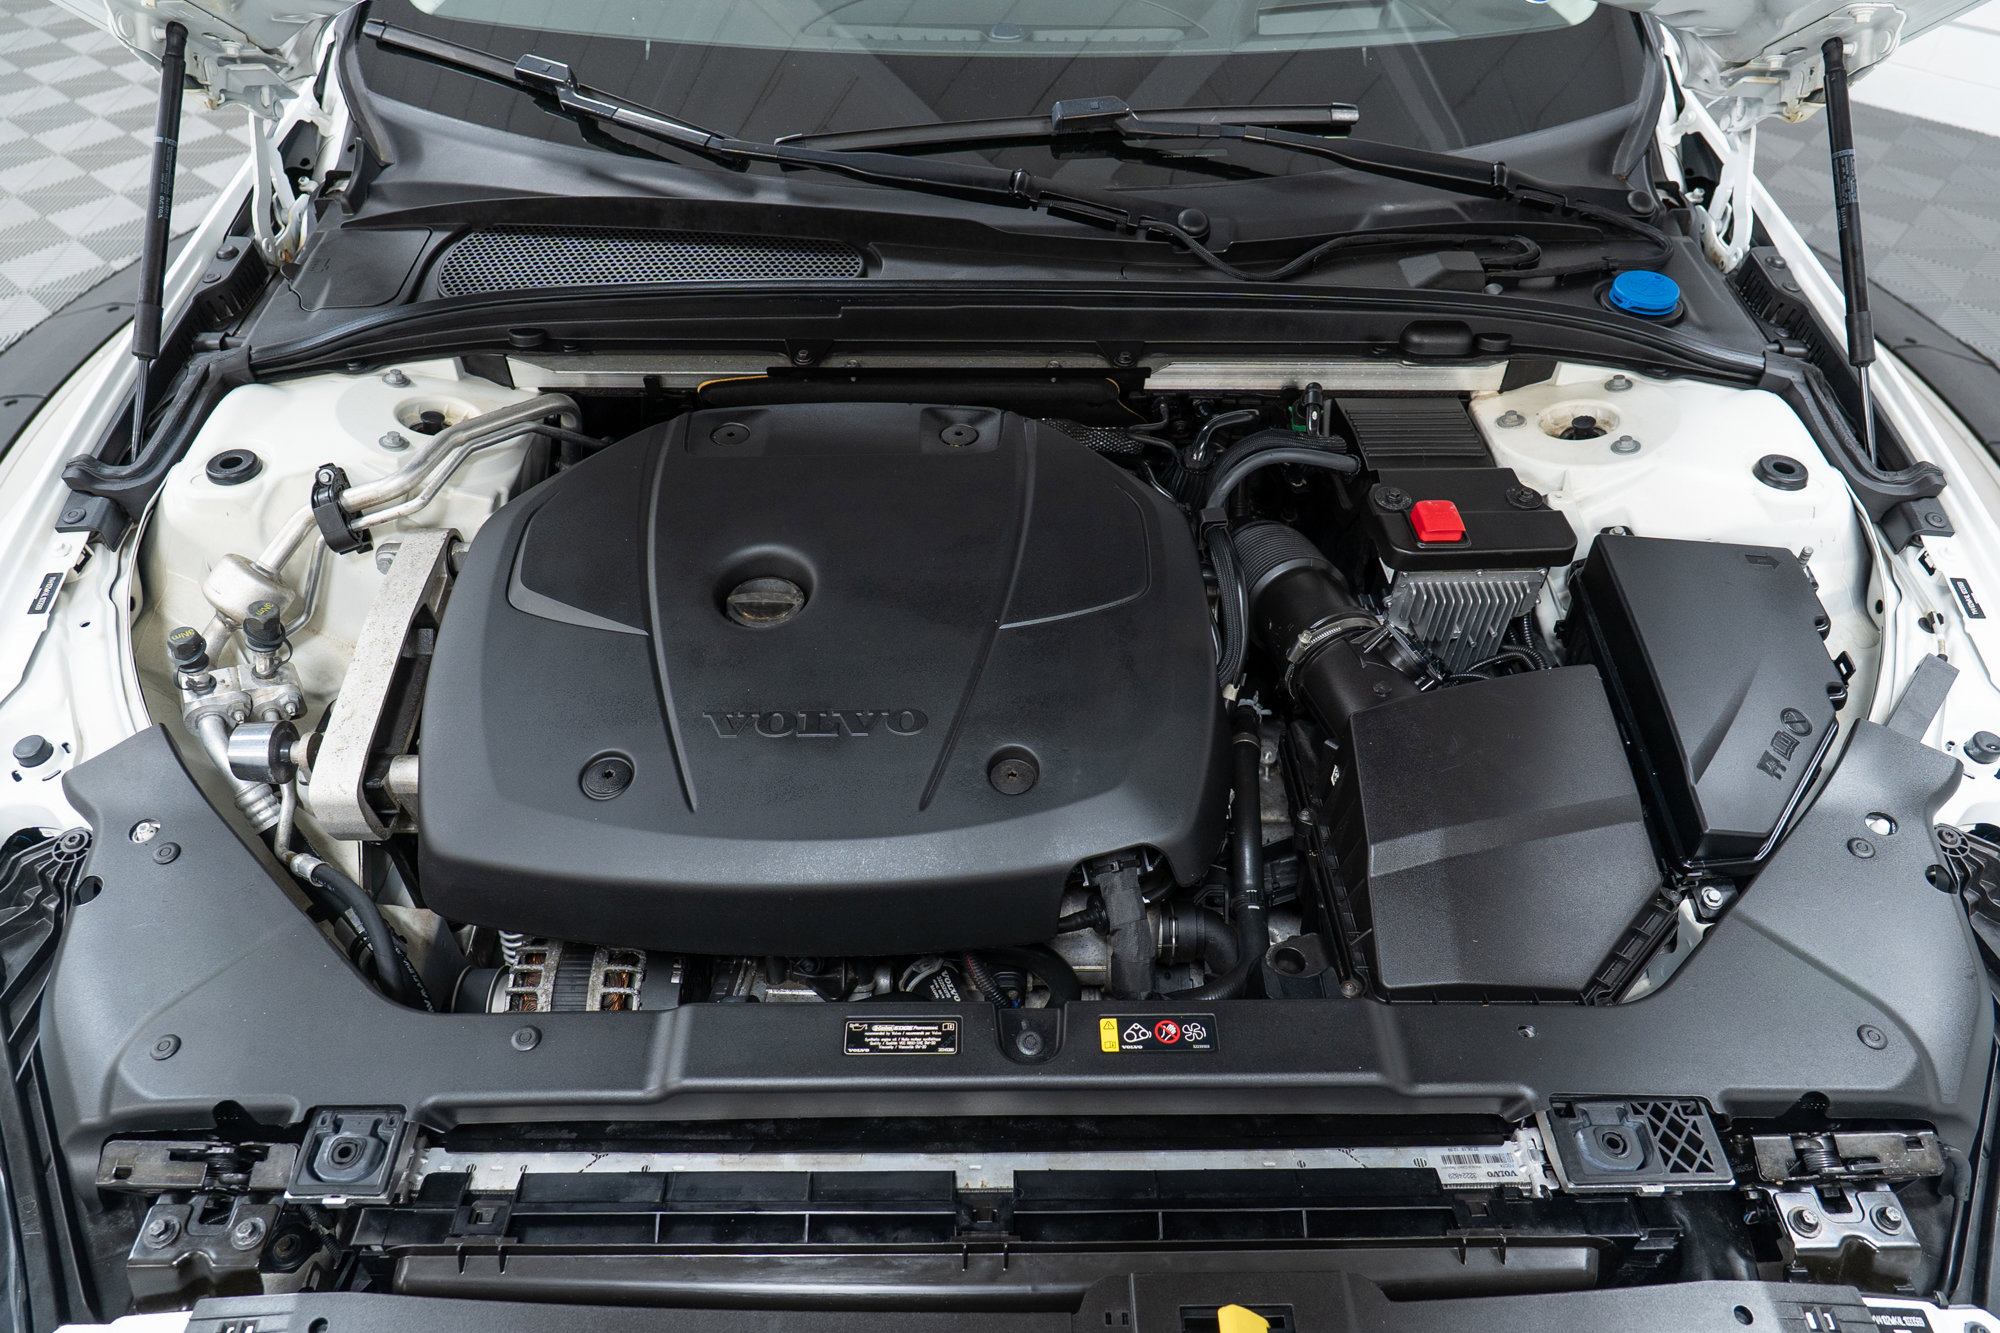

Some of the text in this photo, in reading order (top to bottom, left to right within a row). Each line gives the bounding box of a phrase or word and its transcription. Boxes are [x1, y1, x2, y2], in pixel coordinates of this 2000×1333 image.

[171, 629, 196, 641] 3Nm
[702, 709, 929, 738] VOLVO
[941, 969, 961, 1002] VOLVO
[1486, 1170, 1518, 1178] VOLVO
